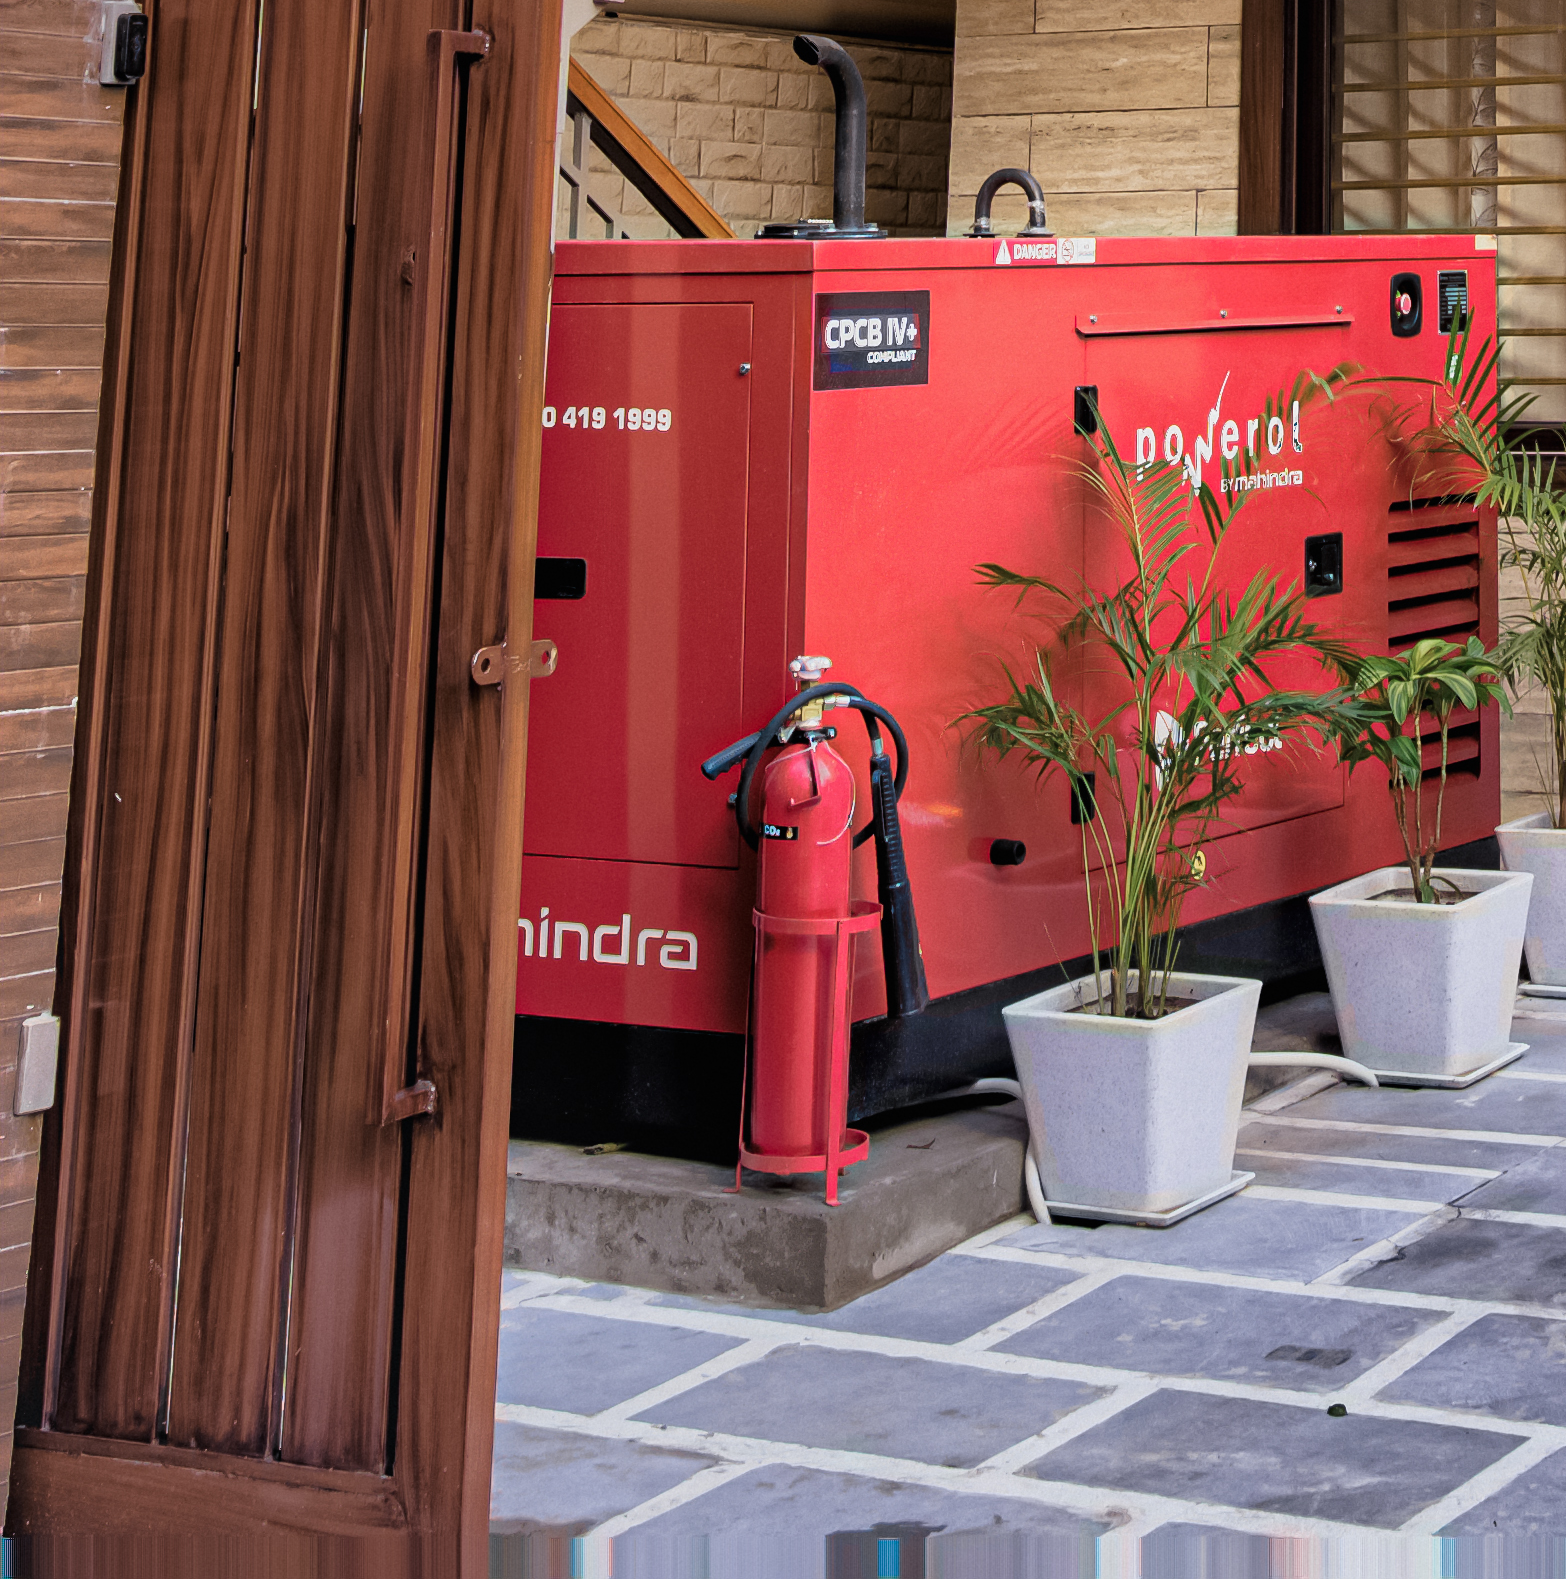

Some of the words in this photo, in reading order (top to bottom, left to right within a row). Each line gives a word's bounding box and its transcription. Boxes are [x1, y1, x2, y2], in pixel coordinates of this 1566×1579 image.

[1013, 243, 1057, 260] DANGER
[825, 317, 883, 349] CPCB
[886, 316, 918, 346] IV+
[866, 350, 917, 364] COMPLIANT
[562, 406, 606, 430] 419
[612, 407, 672, 431] 1999
[1234, 467, 1303, 492] mahindra
